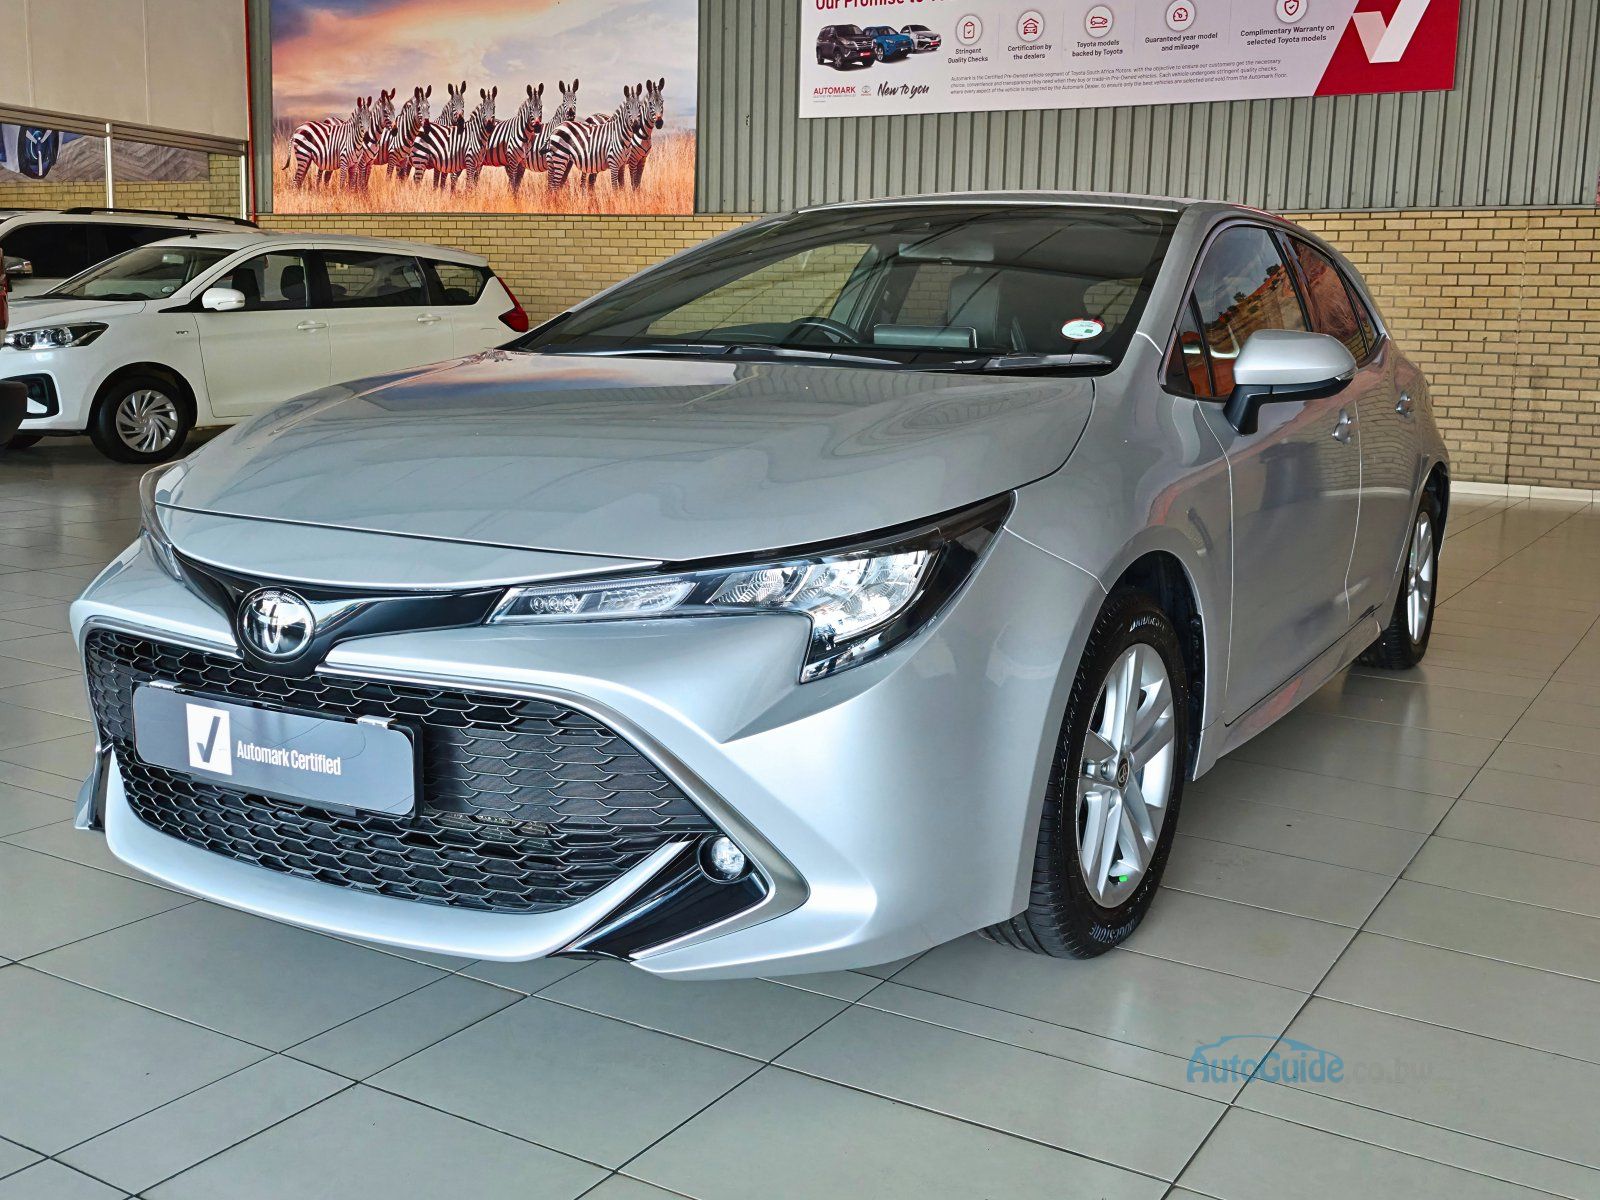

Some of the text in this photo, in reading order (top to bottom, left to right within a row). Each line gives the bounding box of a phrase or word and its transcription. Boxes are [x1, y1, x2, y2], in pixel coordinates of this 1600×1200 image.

[816, 0, 904, 10] Our Prom
[1240, 27, 1292, 37] Complimentary
[1293, 26, 1324, 34] Warranty
[1144, 35, 1182, 44] Guaranteed
[1182, 35, 1197, 43] year
[1246, 34, 1326, 46] selected Toyota models
[1174, 43, 1200, 51] mileage
[814, 86, 856, 94] AUTOMARK
[878, 81, 930, 100] New to you
[237, 740, 342, 776] Automark Certified
